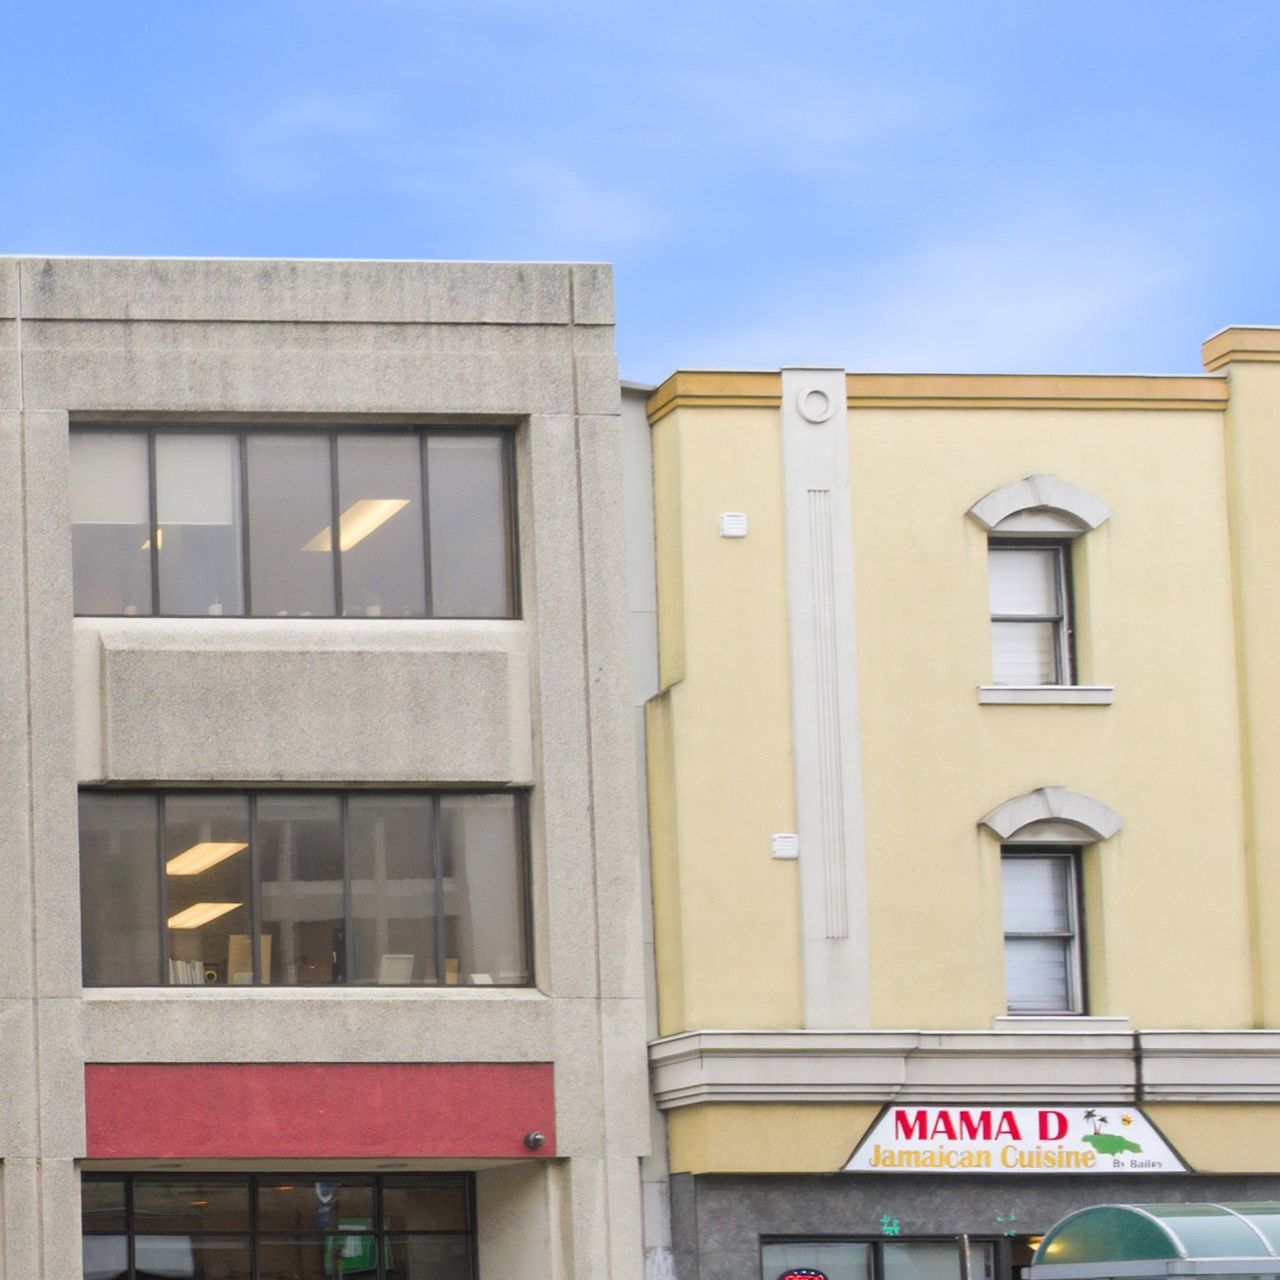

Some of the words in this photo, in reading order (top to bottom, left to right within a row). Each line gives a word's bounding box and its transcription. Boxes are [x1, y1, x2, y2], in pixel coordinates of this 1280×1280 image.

[894, 1109, 1023, 1141] MAMA
[1039, 1109, 1069, 1141] D
[868, 1143, 992, 1169] Jamaican
[1000, 1143, 1097, 1169] Cuisine
[1129, 1159, 1163, 1169] Bailey
